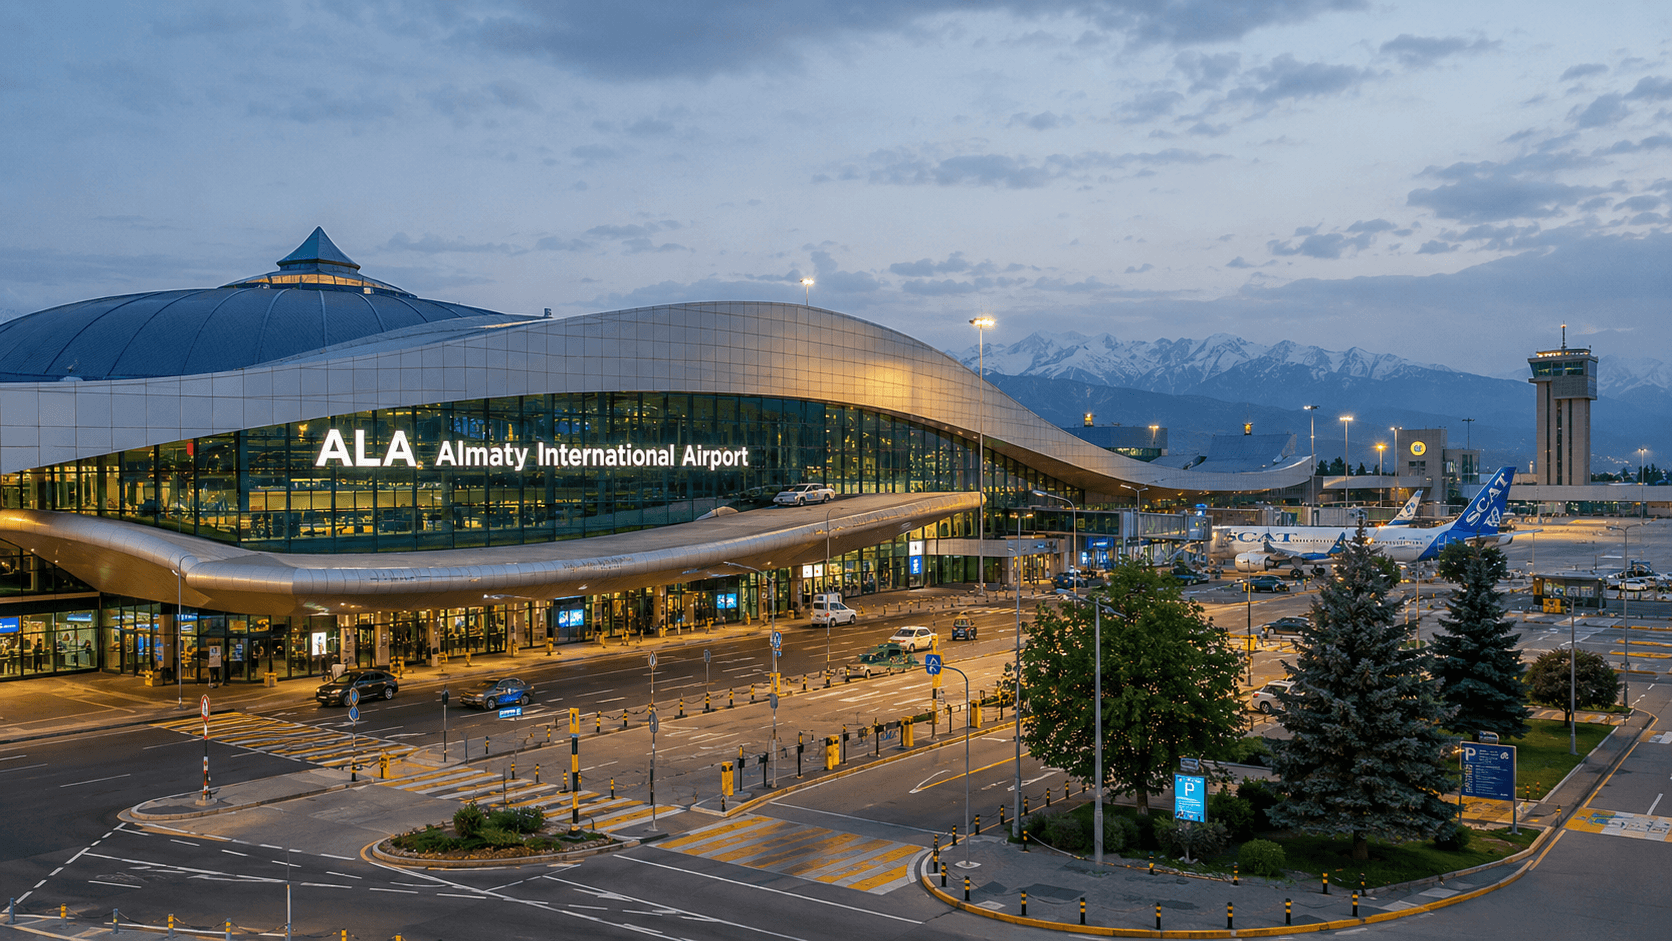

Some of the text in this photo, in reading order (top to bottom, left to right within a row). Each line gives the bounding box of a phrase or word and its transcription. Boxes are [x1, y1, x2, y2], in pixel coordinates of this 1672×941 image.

[315, 428, 749, 471] ALA Almaty International Airport
[1465, 472, 1508, 527] SCAT
[1465, 747, 1476, 761] P
[1185, 782, 1195, 796] P
